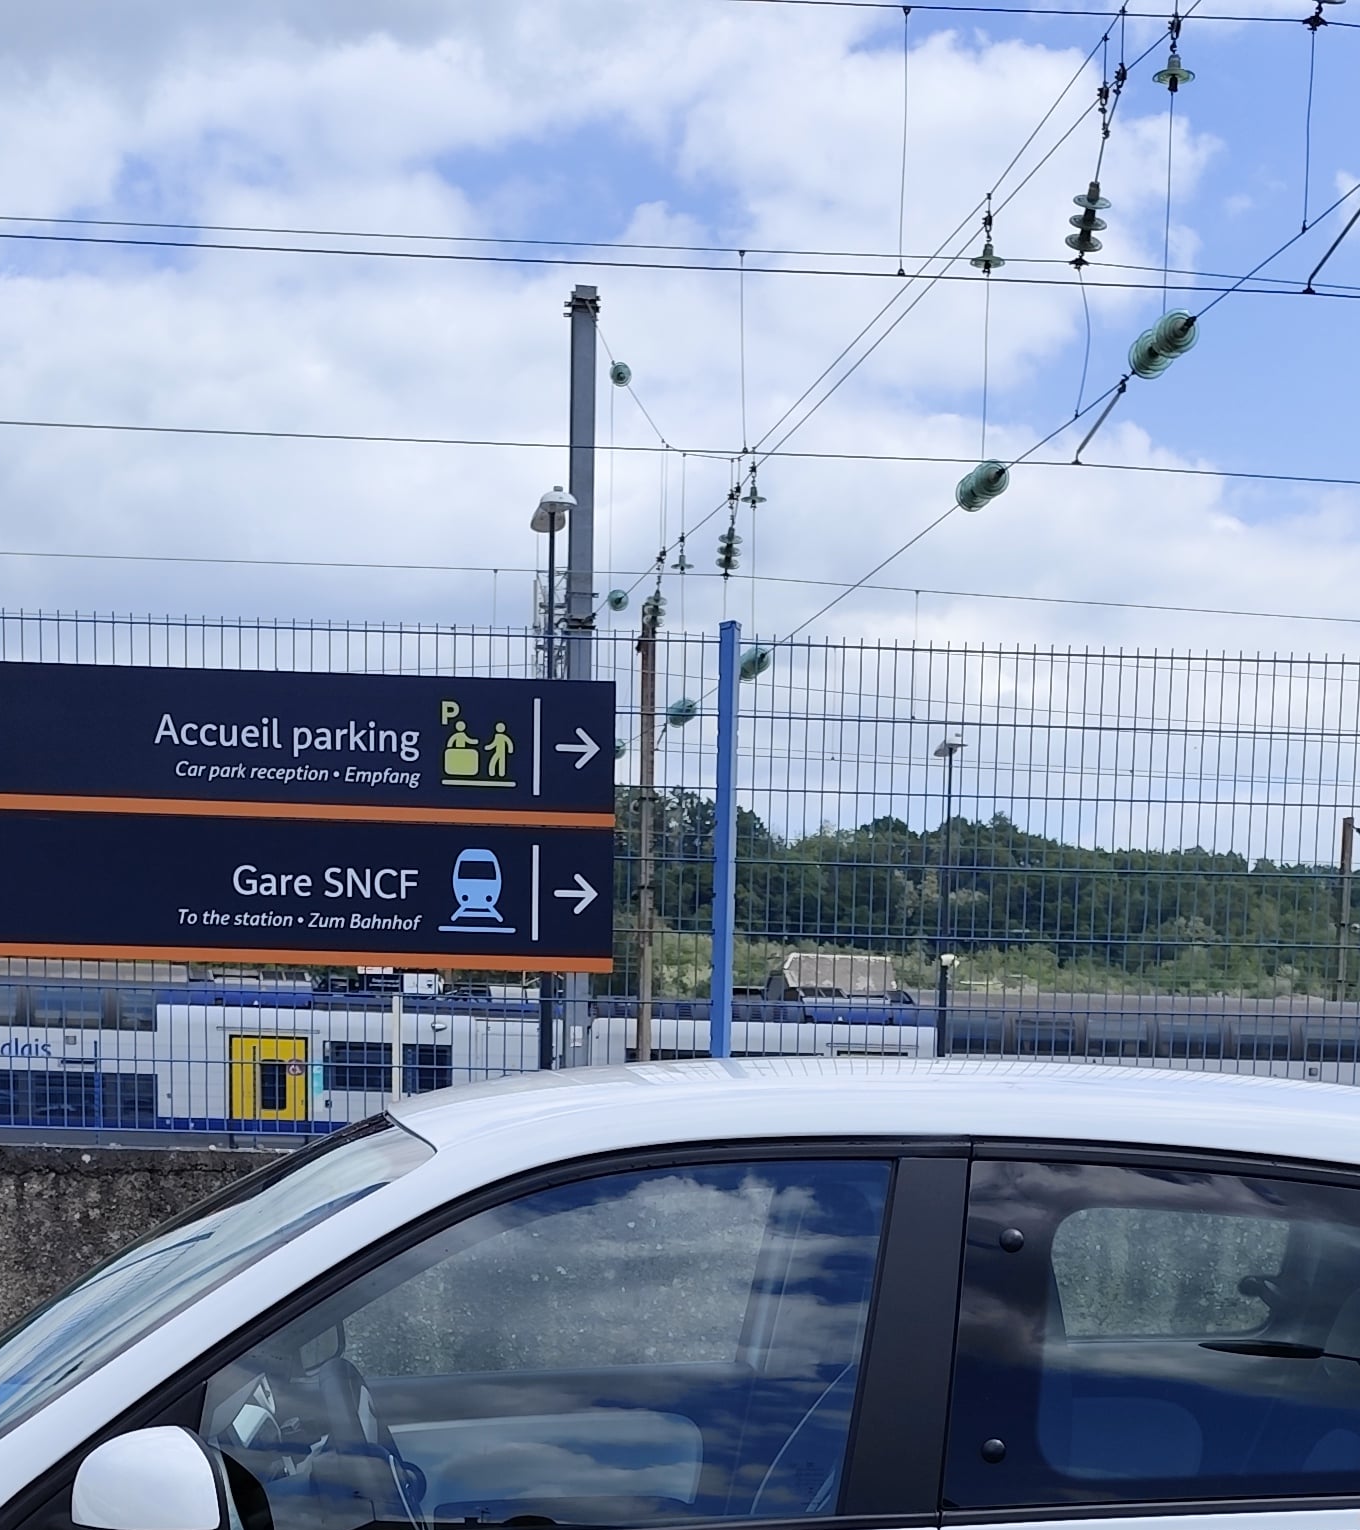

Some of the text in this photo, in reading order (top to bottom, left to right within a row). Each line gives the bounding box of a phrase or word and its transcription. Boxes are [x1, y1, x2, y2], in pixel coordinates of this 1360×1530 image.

[441, 700, 460, 725] P
[154, 713, 420, 762] Accueil parking
[175, 760, 421, 789] Car park reception Empfang
[232, 864, 419, 900] Gare SNCF
[178, 908, 423, 931] To the station Zum Bahnhof
